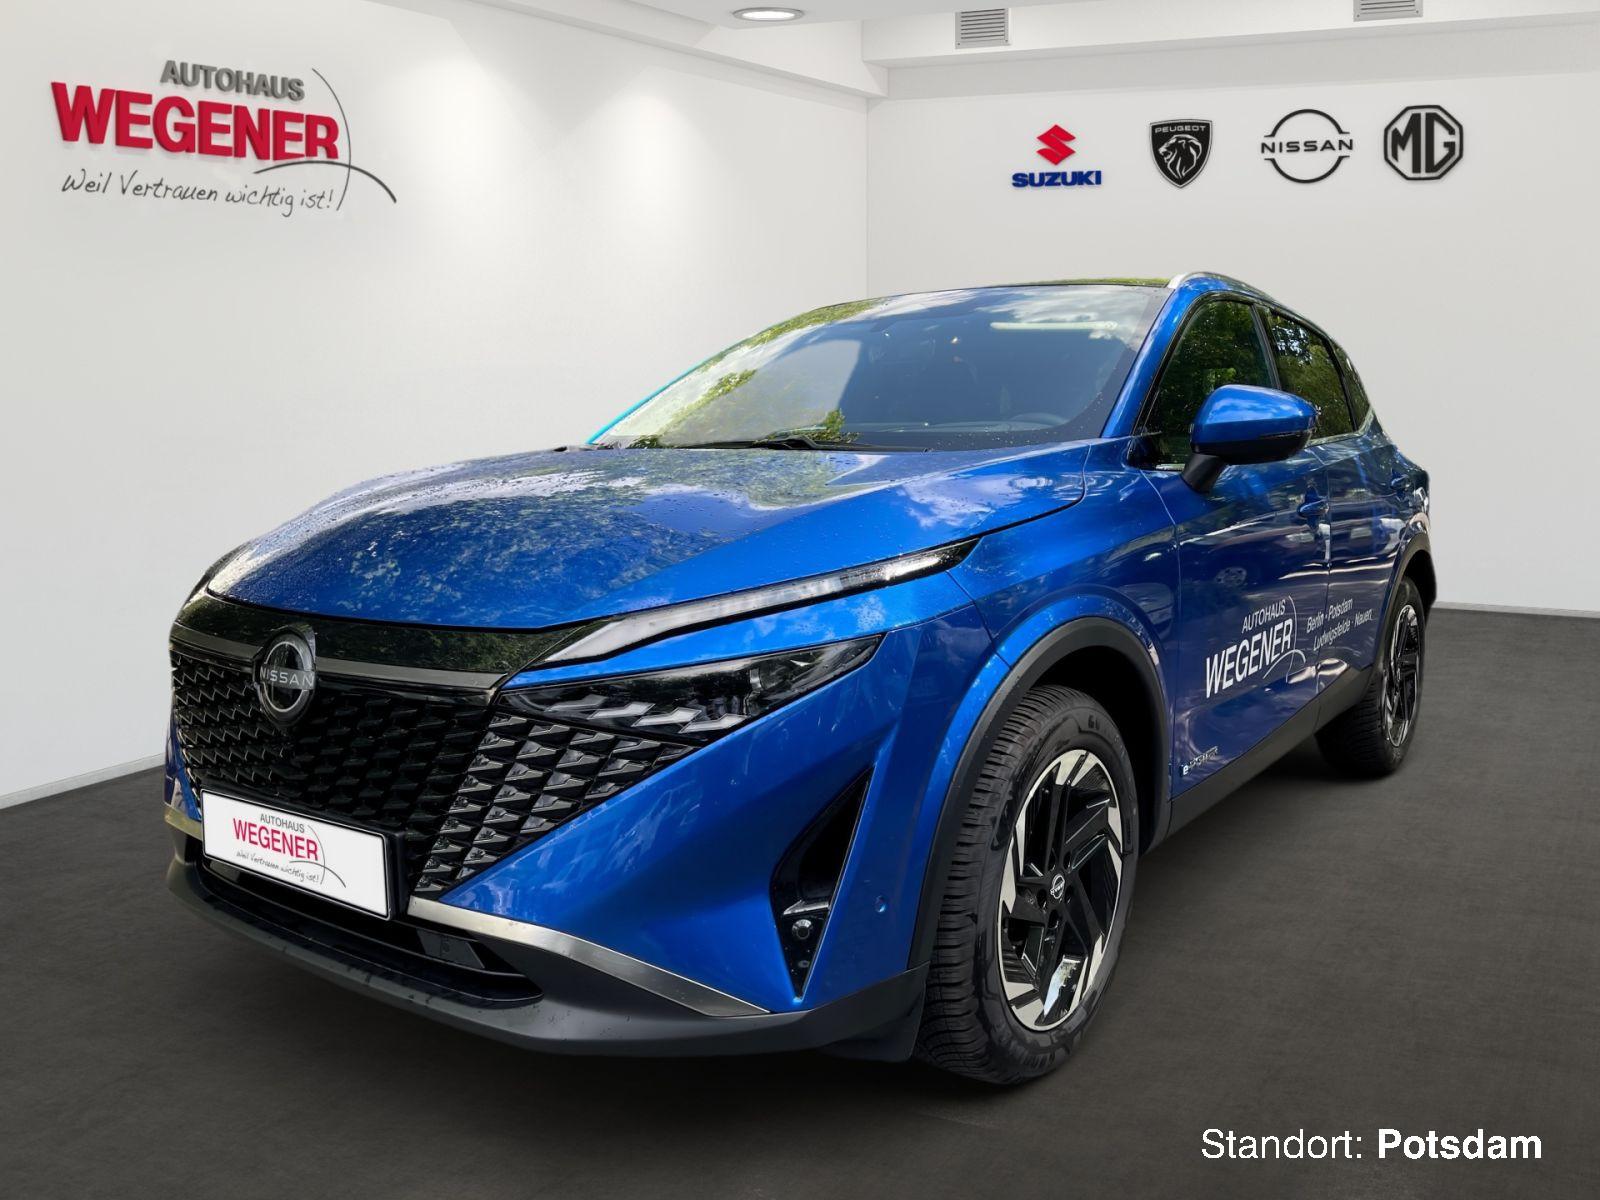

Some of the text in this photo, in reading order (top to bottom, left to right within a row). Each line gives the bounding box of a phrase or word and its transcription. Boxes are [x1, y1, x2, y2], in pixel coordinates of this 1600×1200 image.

[160, 60, 305, 102] AUTOHAUS
[51, 81, 340, 161] WEGENER
[1154, 125, 1206, 134] PEUGEOT
[1260, 138, 1354, 154] NISSAN
[1390, 111, 1457, 175] MG
[62, 168, 335, 218] Weil Vertrauen wichtig ist!
[1011, 170, 1102, 188] SUZUKI
[1242, 599, 1286, 634] AUTOHAUS
[1306, 598, 1353, 634] Berlin Potsdam
[1313, 608, 1373, 651] Ludwigsfelde Nauen
[259, 666, 315, 689] NISSAN
[1205, 618, 1294, 699] WEGENER
[233, 818, 319, 862] WEGENER
[260, 813, 305, 834] AUTOHAUS
